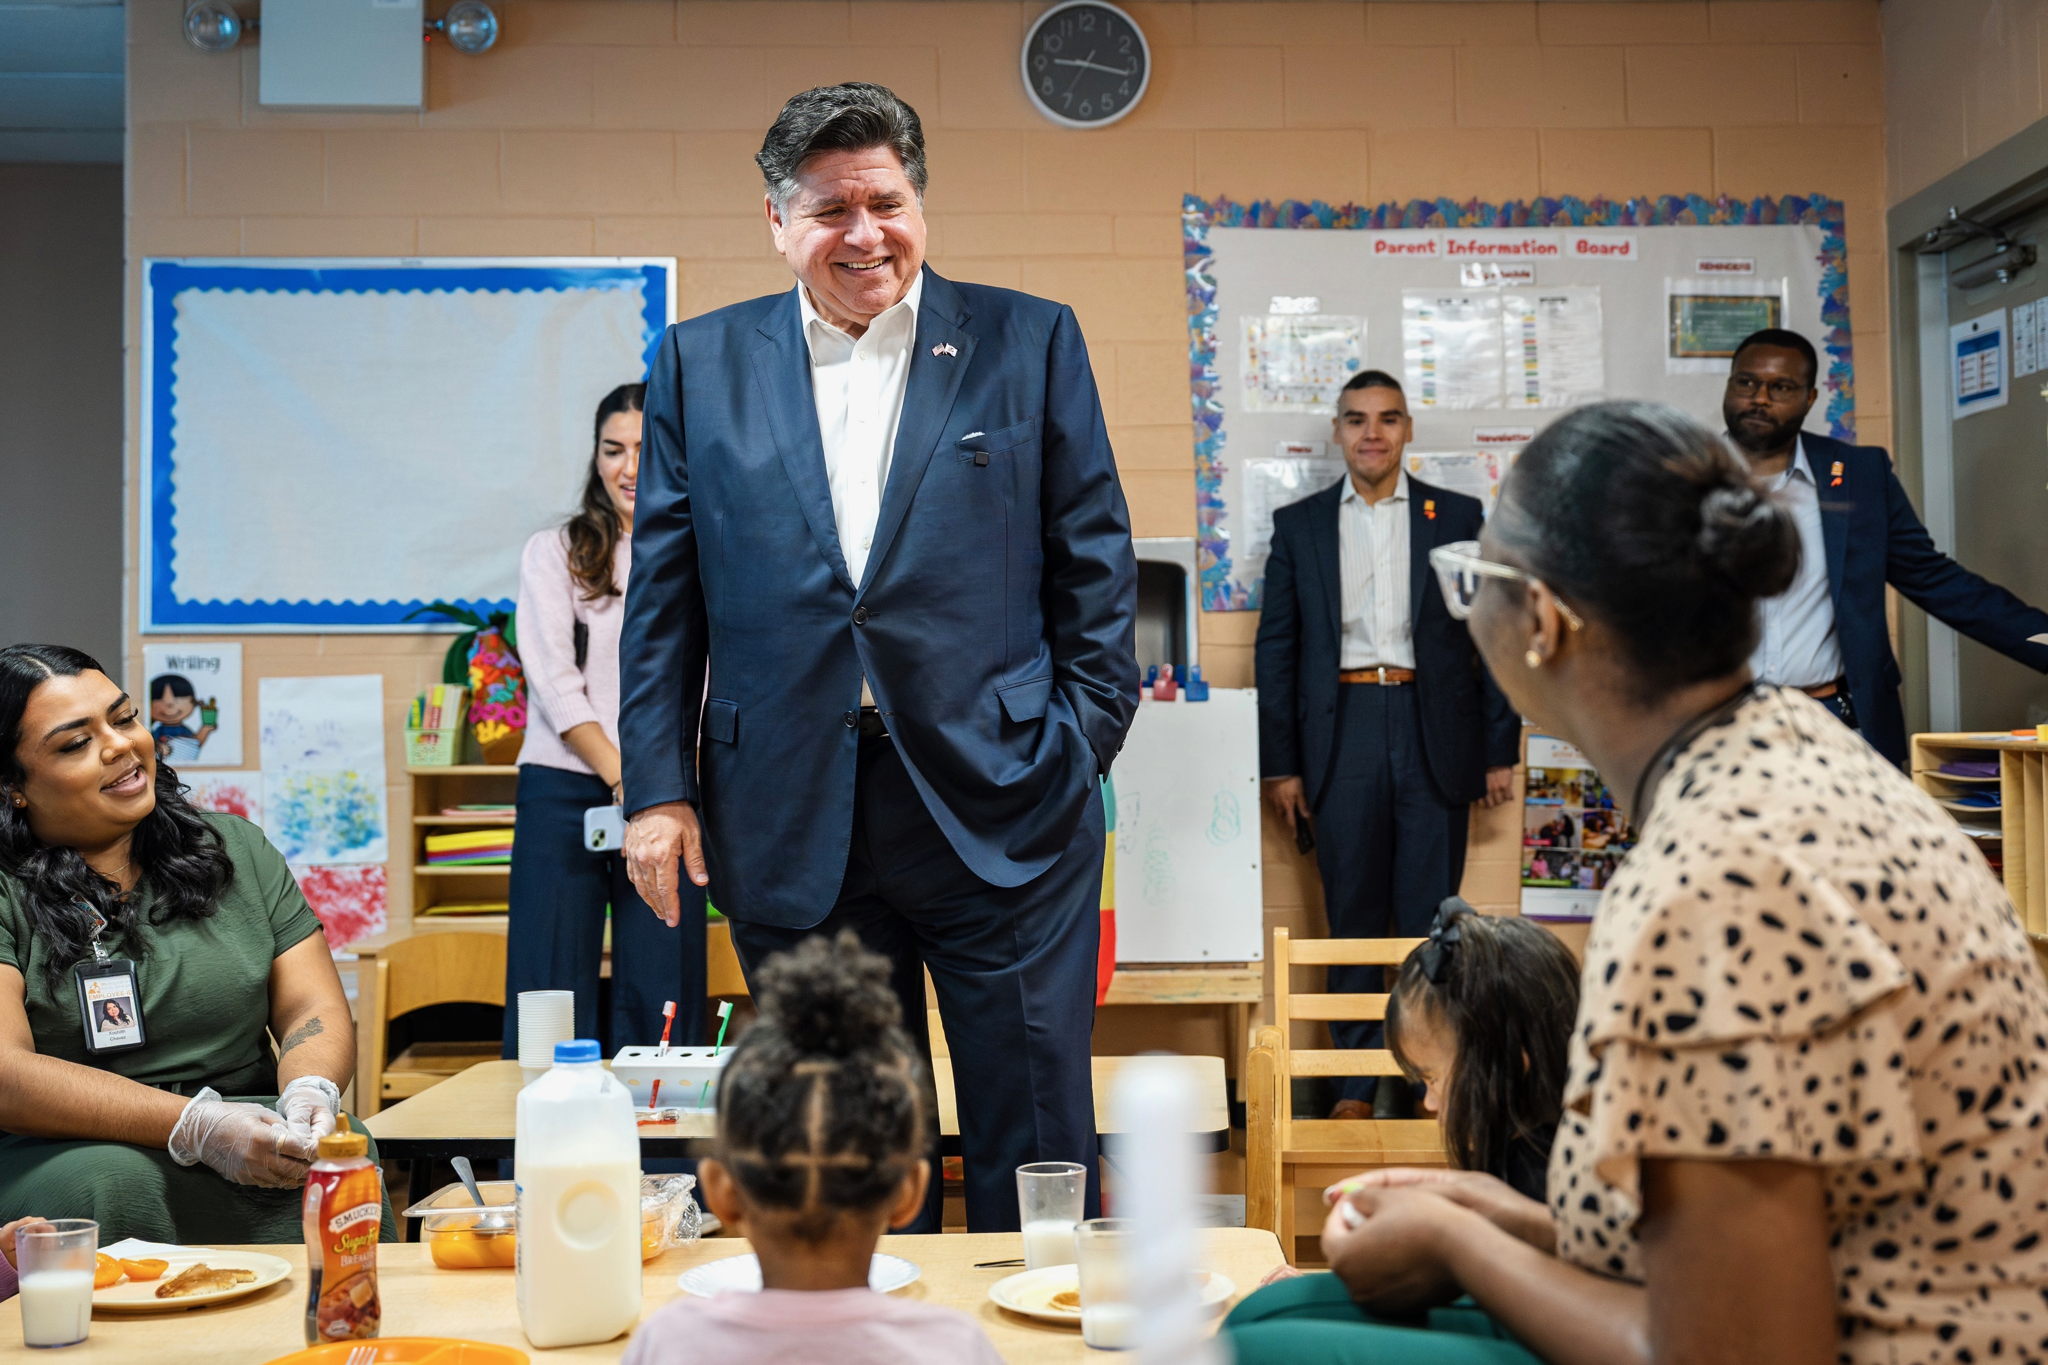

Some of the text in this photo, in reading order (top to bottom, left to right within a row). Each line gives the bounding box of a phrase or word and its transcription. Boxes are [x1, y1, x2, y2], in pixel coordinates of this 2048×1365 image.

[1060, 19, 1073, 37] 11
[1078, 10, 1095, 32] 12
[1106, 20, 1111, 37] 1
[1043, 34, 1063, 53] 10
[1118, 35, 1131, 54] 2
[1034, 54, 1047, 71] 9
[1041, 76, 1054, 96] 8
[1118, 80, 1130, 96] 4
[1063, 92, 1074, 109] 7
[1078, 98, 1092, 117] 6
[1100, 93, 1114, 111] 5
[1374, 239, 1630, 255] Parent Information Board
[166, 654, 221, 674] Writing
